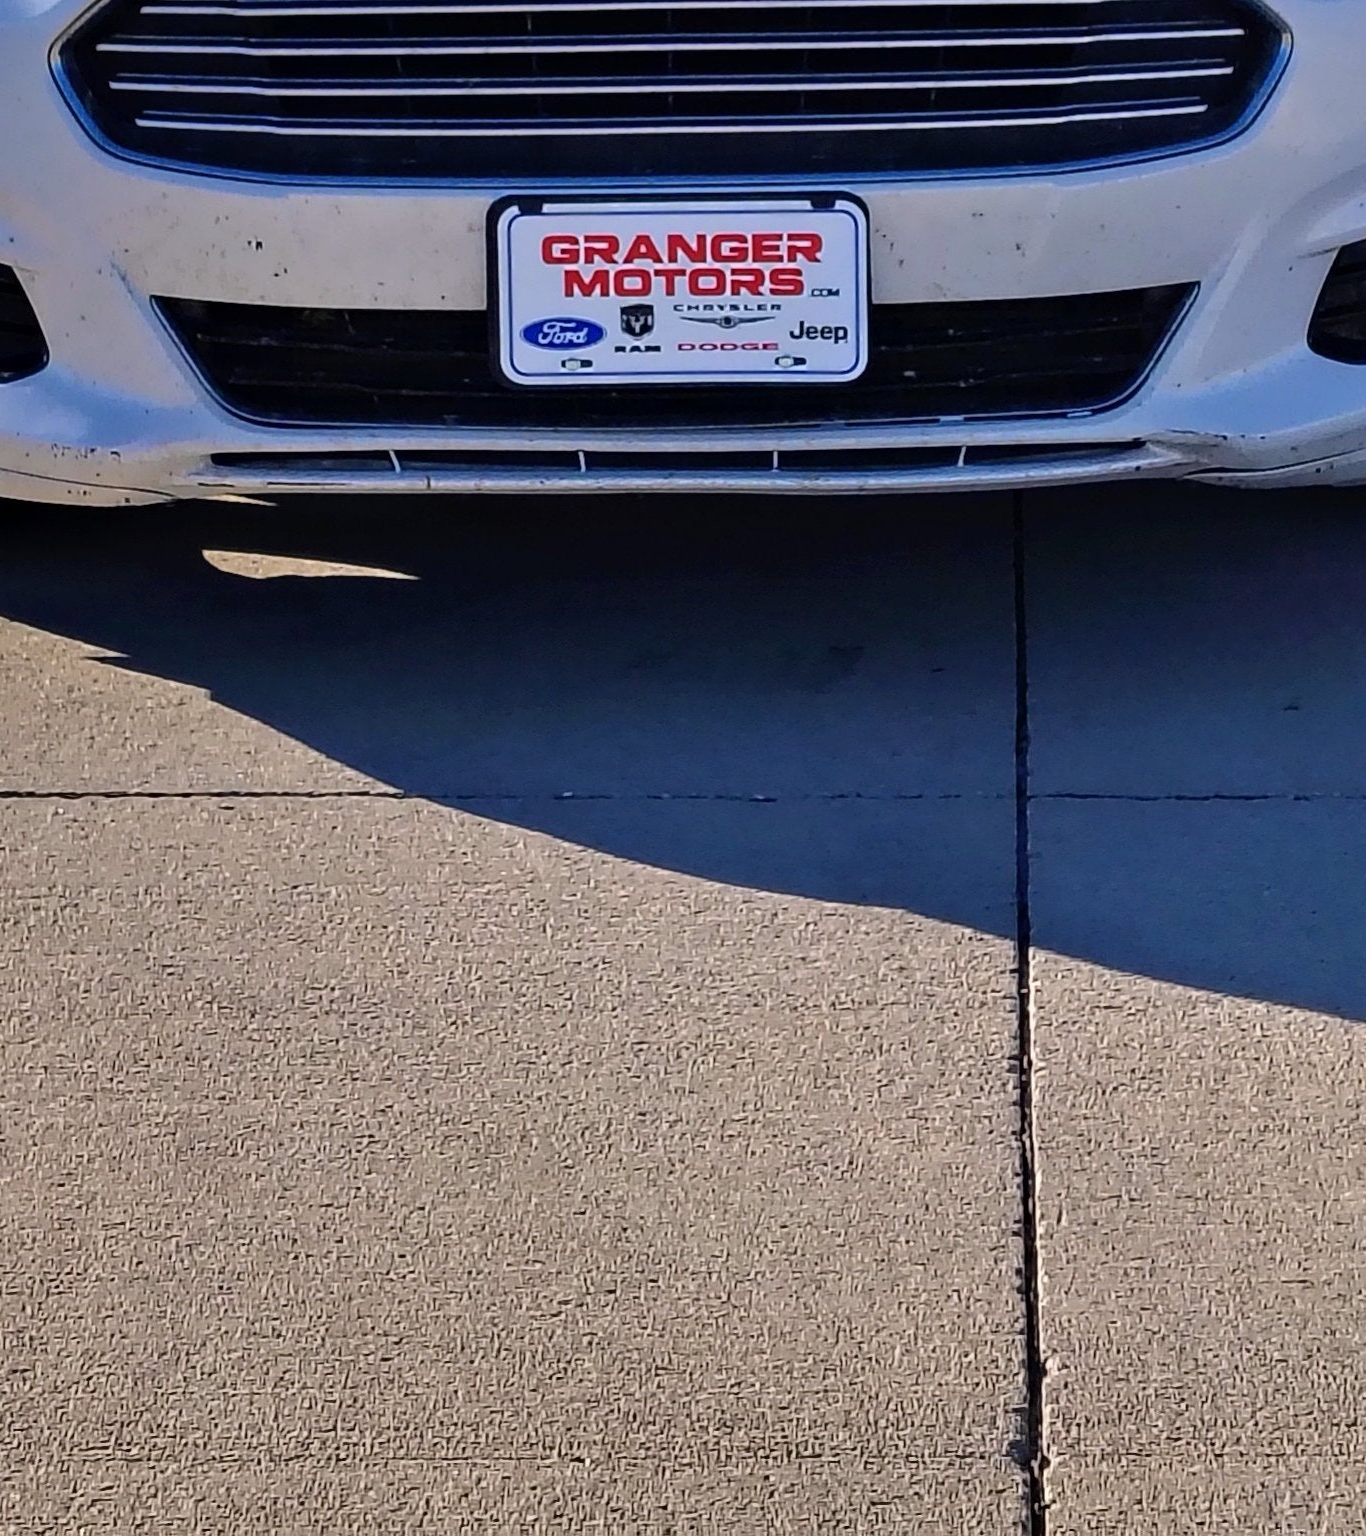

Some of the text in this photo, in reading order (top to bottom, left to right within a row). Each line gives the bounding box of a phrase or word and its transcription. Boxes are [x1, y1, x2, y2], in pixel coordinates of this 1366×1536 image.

[541, 233, 823, 265] GRANGER
[564, 268, 804, 298] MOTORS
[673, 304, 782, 312] CHRYSLER
[537, 321, 588, 345] Ford
[789, 321, 848, 344] Jeep
[614, 345, 662, 353] RAM
[677, 343, 779, 352] DODGE
